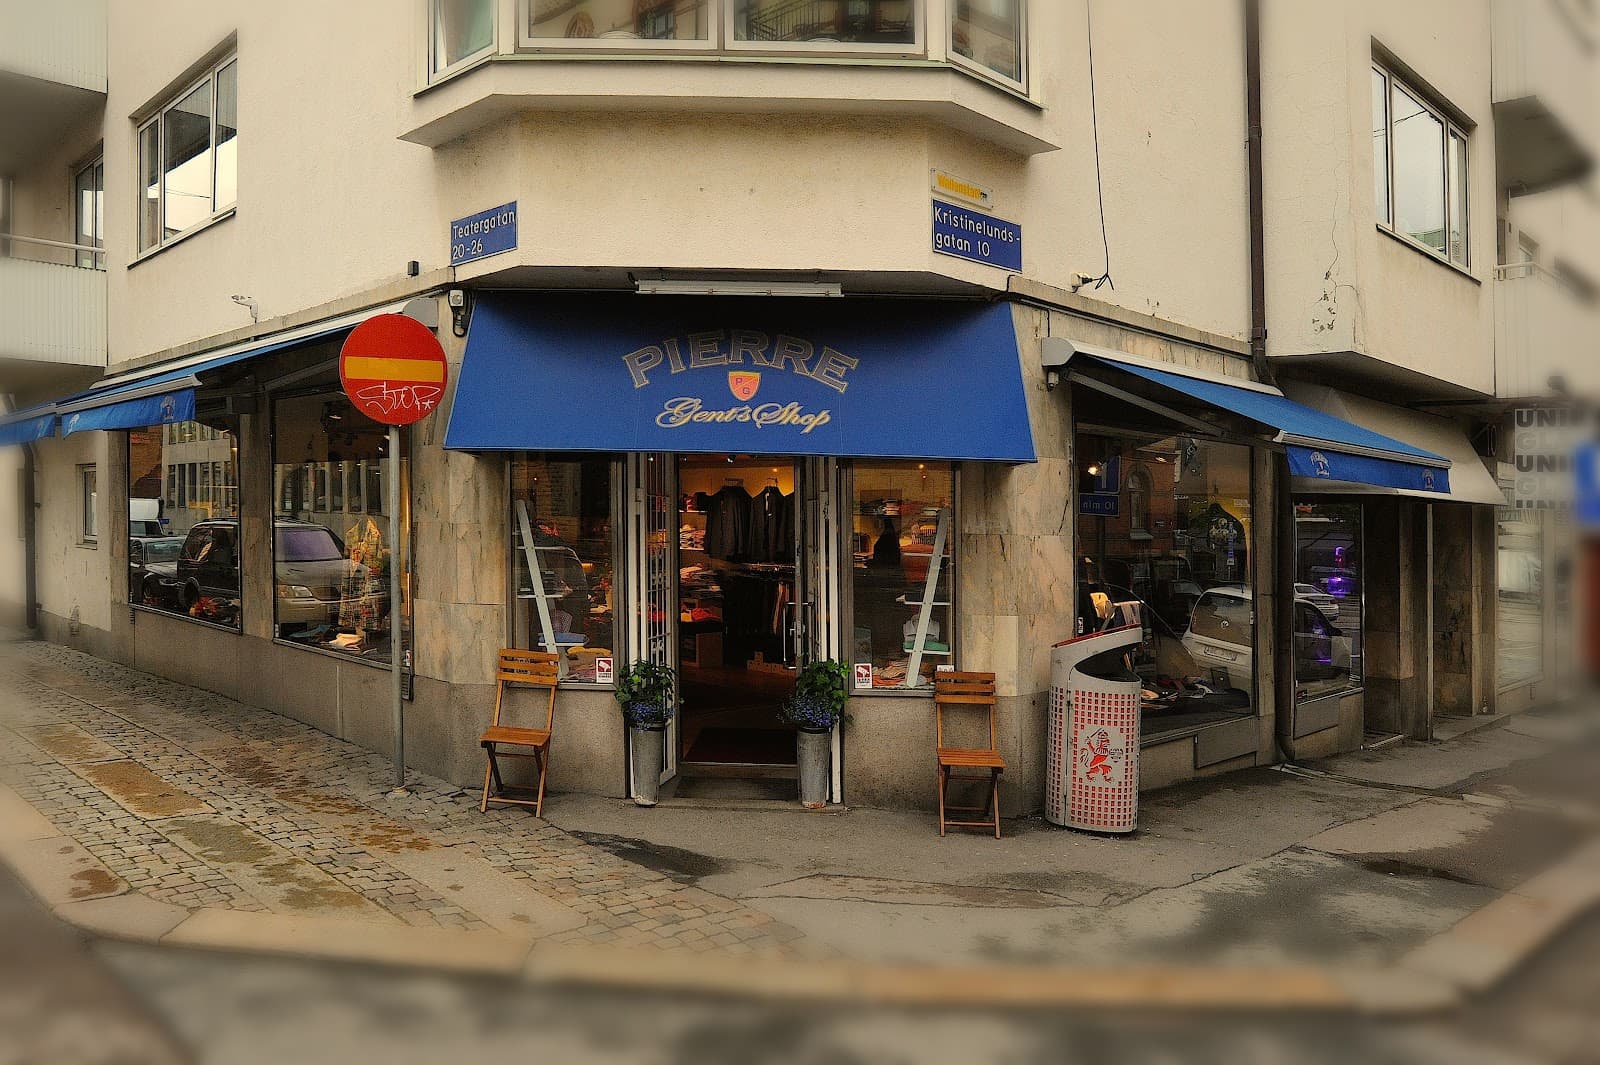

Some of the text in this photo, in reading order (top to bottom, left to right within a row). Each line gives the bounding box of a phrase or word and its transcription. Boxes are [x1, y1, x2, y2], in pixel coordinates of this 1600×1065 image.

[453, 211, 515, 239] Teatergatan
[934, 206, 1020, 242] Kristinelunds-
[453, 238, 483, 260] 20-26
[935, 233, 990, 257] gatan 10
[622, 329, 859, 394] PIERRE
[735, 377, 743, 386] P
[742, 386, 751, 395] G
[656, 397, 831, 434] Gent's Shop
